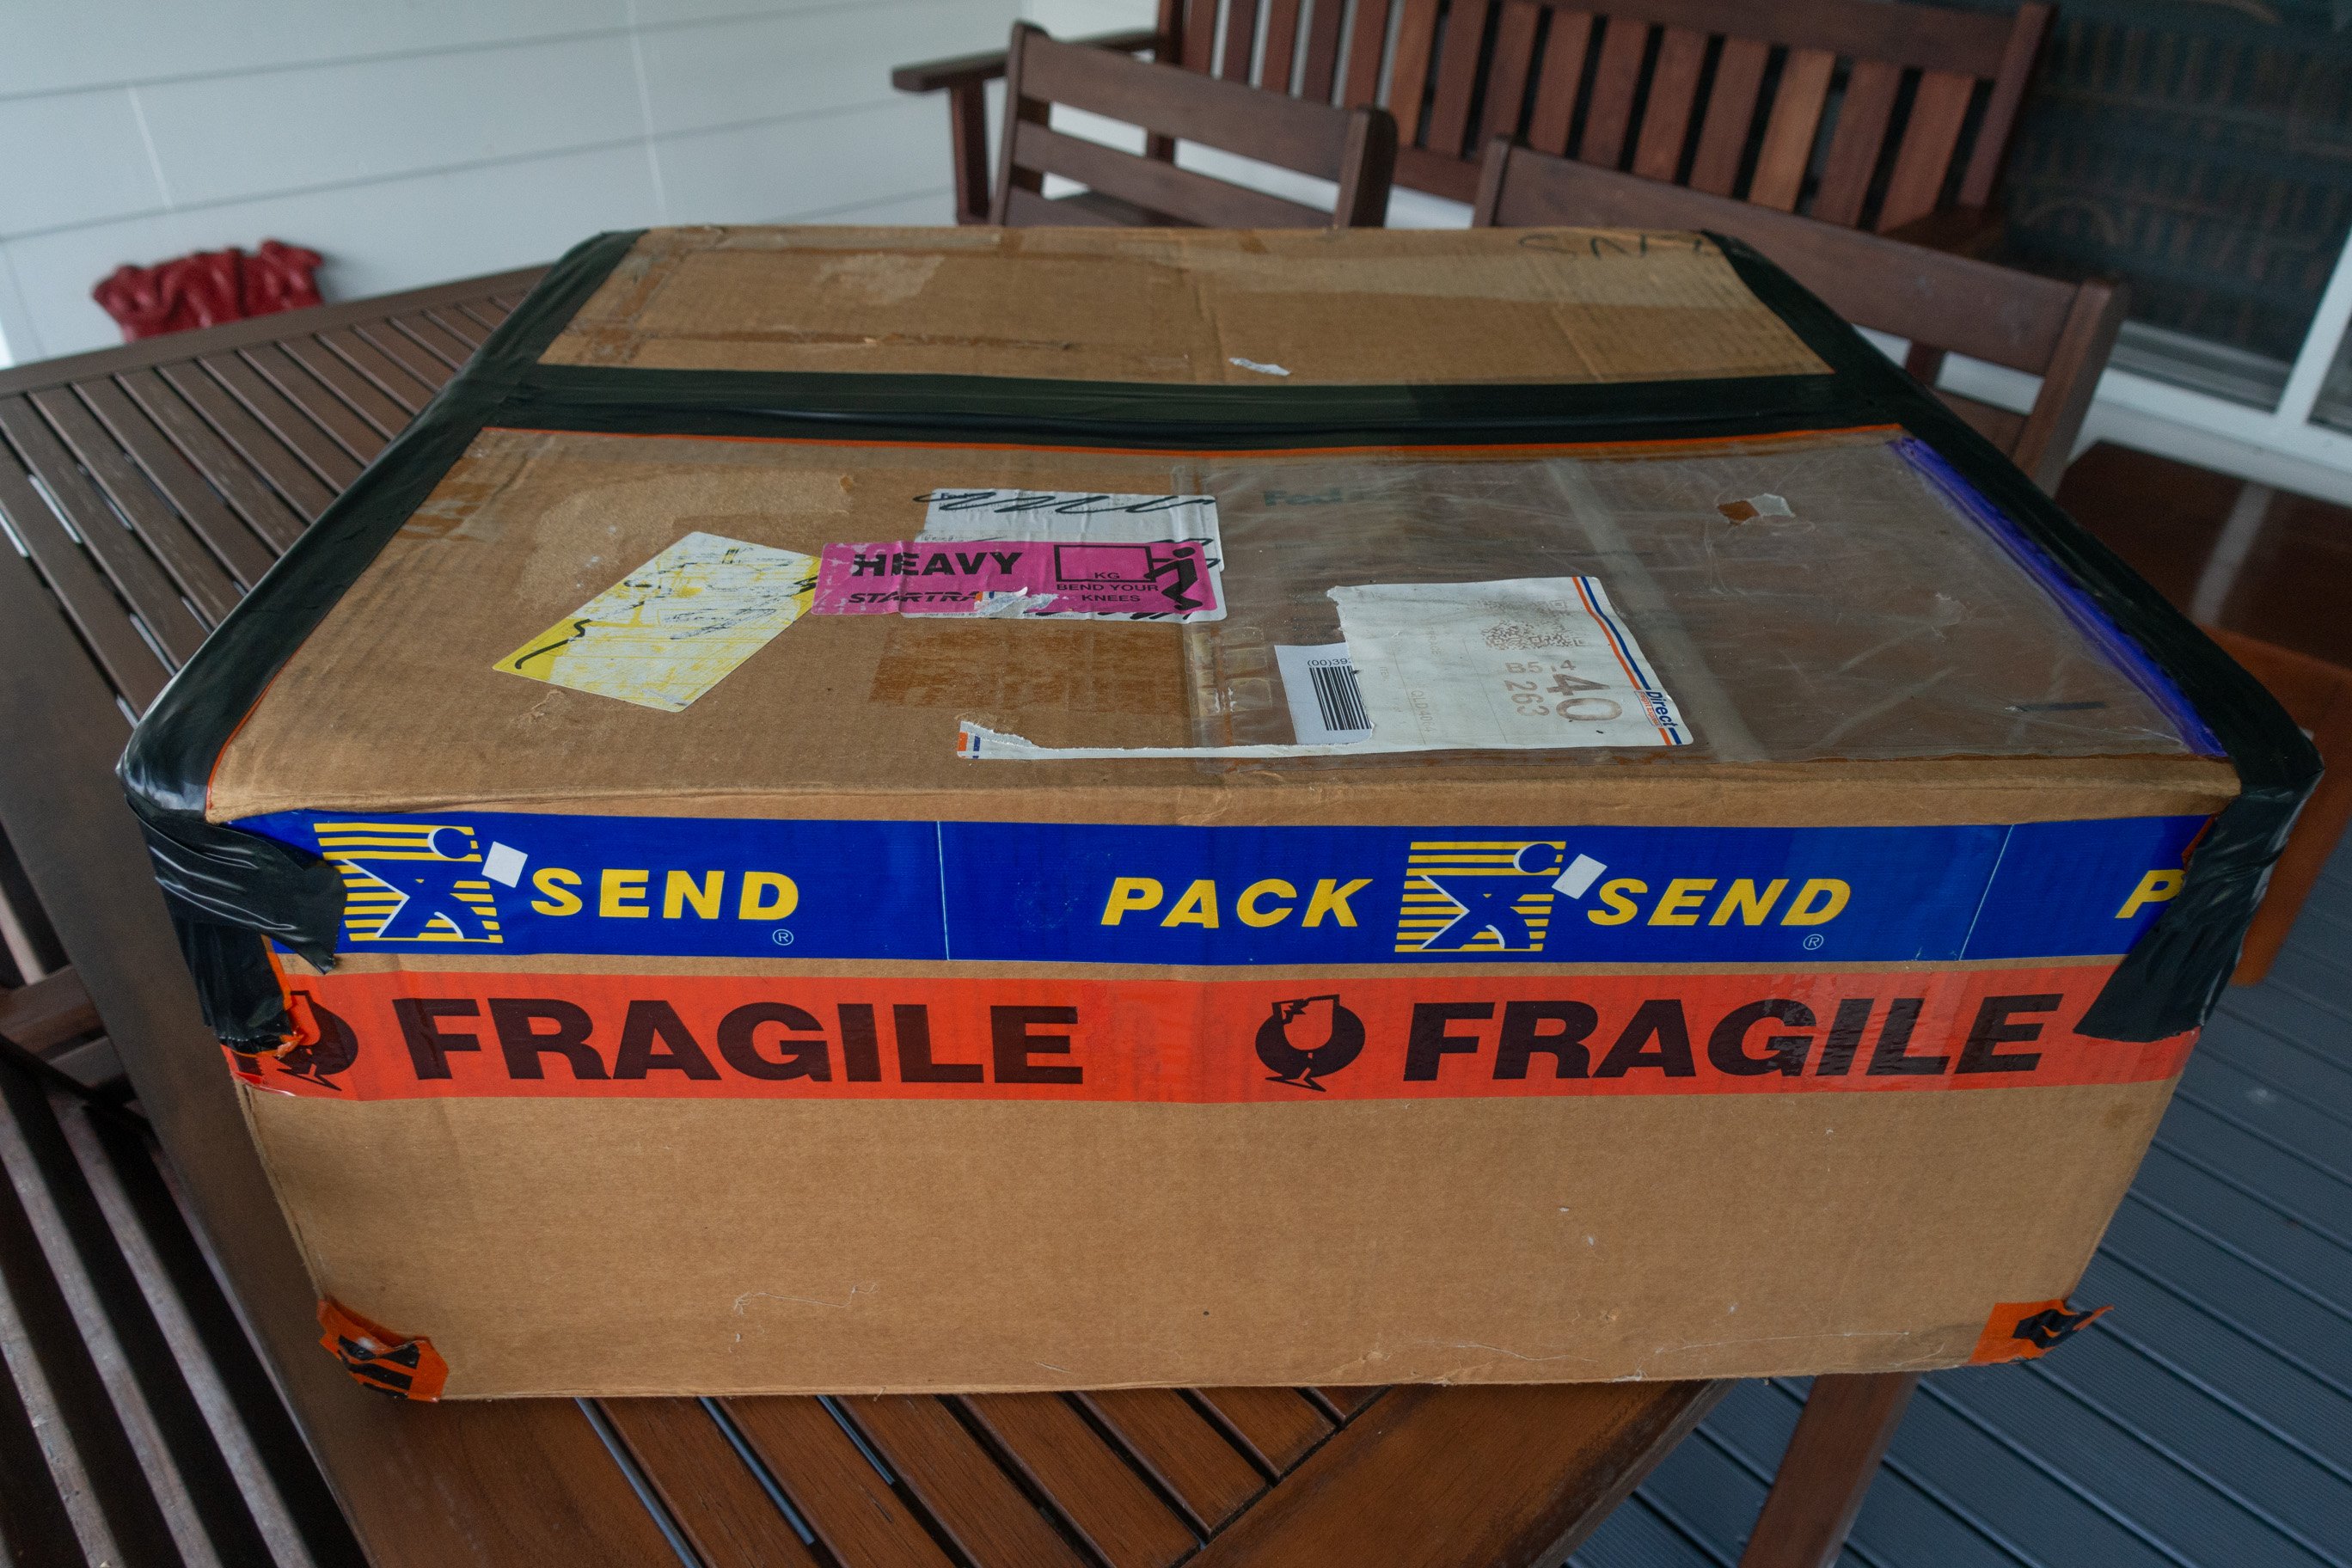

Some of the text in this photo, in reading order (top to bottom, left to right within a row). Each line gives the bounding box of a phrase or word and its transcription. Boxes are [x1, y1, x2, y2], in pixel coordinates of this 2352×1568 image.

[851, 552, 1023, 577] HEAVY
[1109, 584, 1159, 592] YOUR
[848, 591, 981, 603] STARTRA
[1504, 679, 1550, 717] 263
[1546, 673, 1623, 721] 40
[1645, 691, 1678, 726] Direct
[531, 867, 799, 920] SEND
[1101, 877, 1373, 928] PACK
[1587, 878, 1852, 926] SEND
[392, 997, 1084, 1084] FRAGILE
[1403, 994, 2064, 1081] FRAGILE
